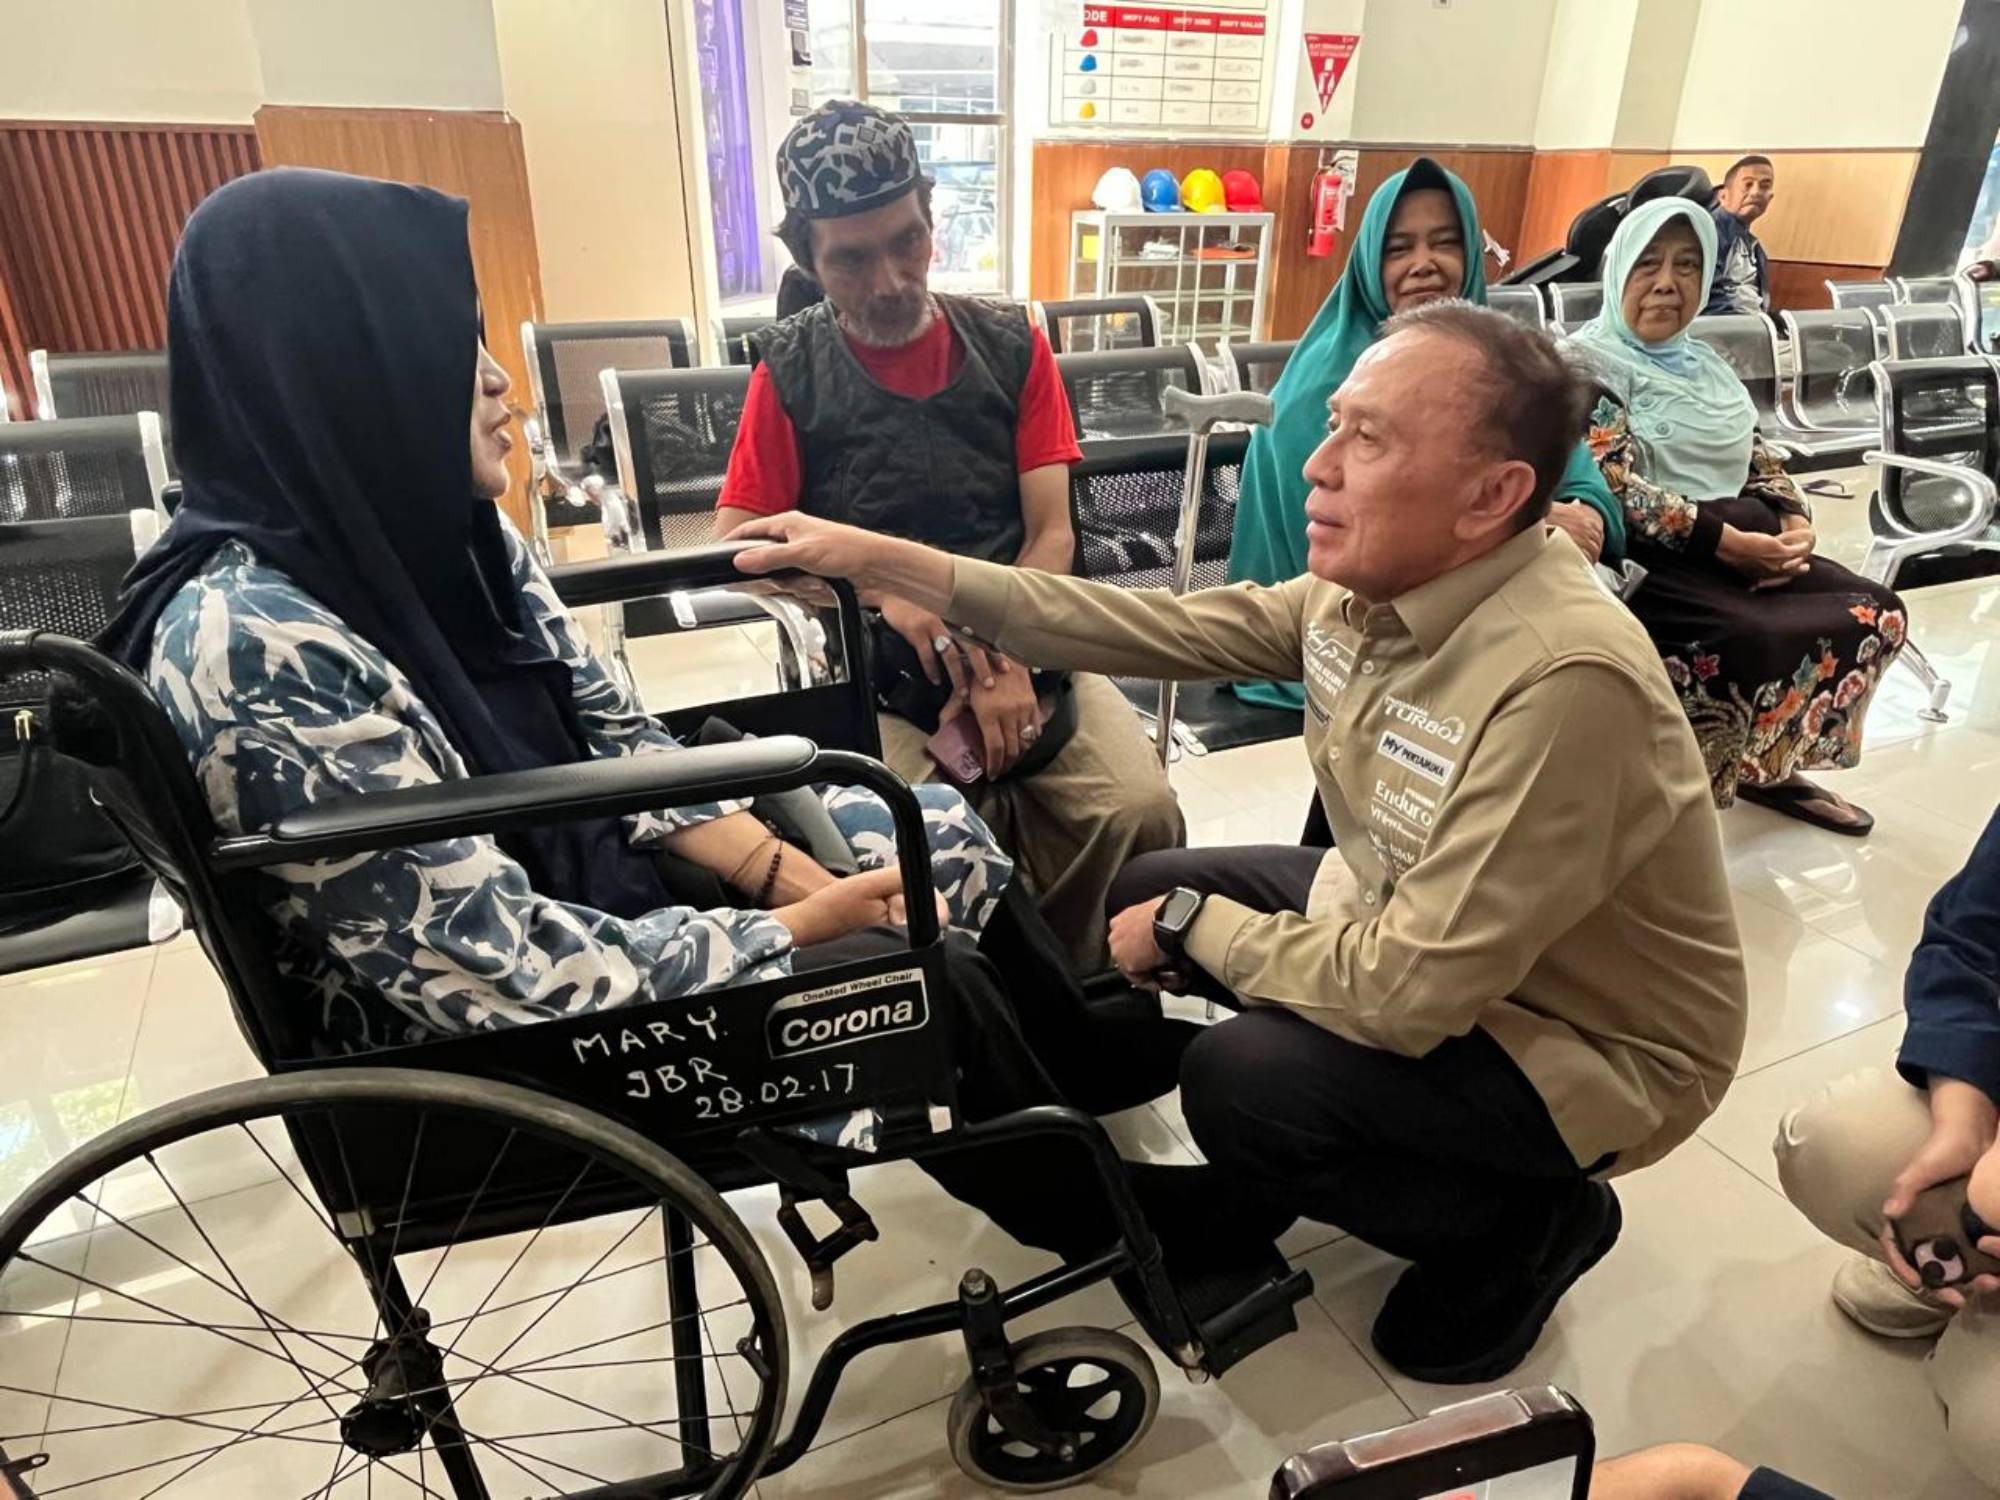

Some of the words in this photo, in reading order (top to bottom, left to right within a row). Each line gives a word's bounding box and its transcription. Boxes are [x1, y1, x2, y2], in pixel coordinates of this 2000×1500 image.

[1083, 9, 1108, 23] ODE
[1384, 699, 1452, 740] TURBO
[1375, 779, 1433, 826] Enduro
[802, 985, 847, 1002] OneMed
[850, 977, 882, 993] Wheel
[884, 972, 913, 986] Chair
[781, 1000, 914, 1047] Corona
